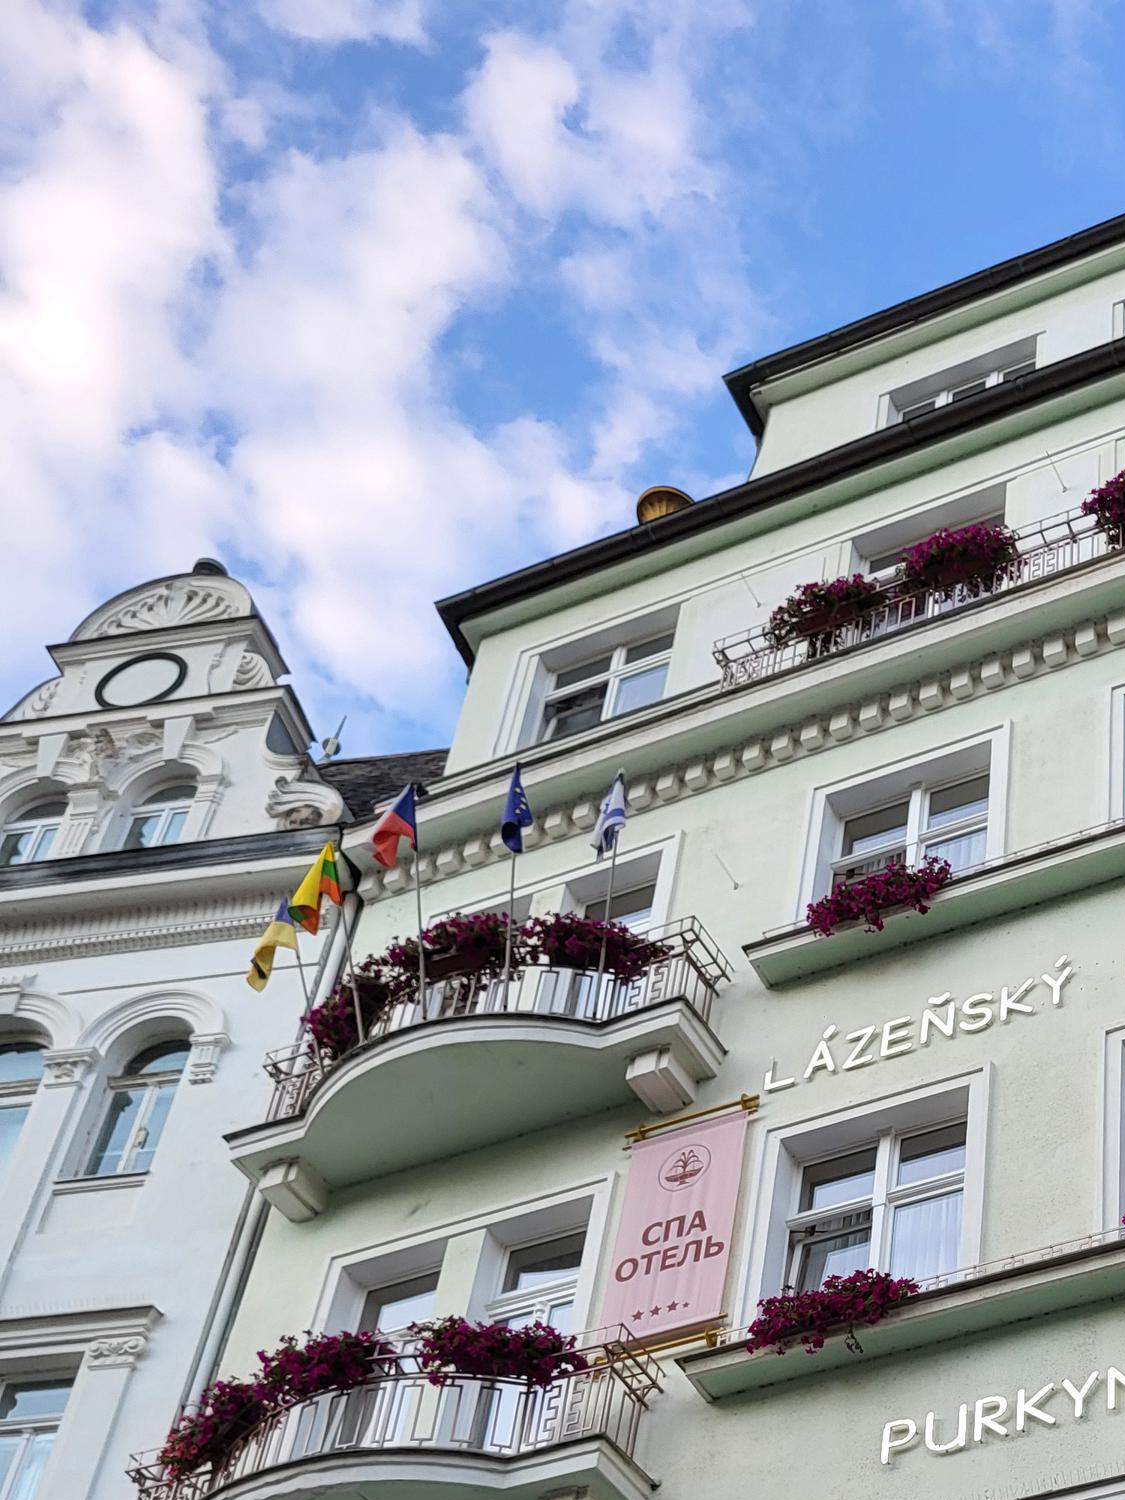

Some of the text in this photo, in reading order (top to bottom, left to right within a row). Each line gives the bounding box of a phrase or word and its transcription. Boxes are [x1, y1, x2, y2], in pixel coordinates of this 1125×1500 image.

[762, 953, 1074, 1093] LÁZEŇSKÝ
[641, 1209, 708, 1247] СПА
[614, 1235, 725, 1283] ОТЕЛЬ
